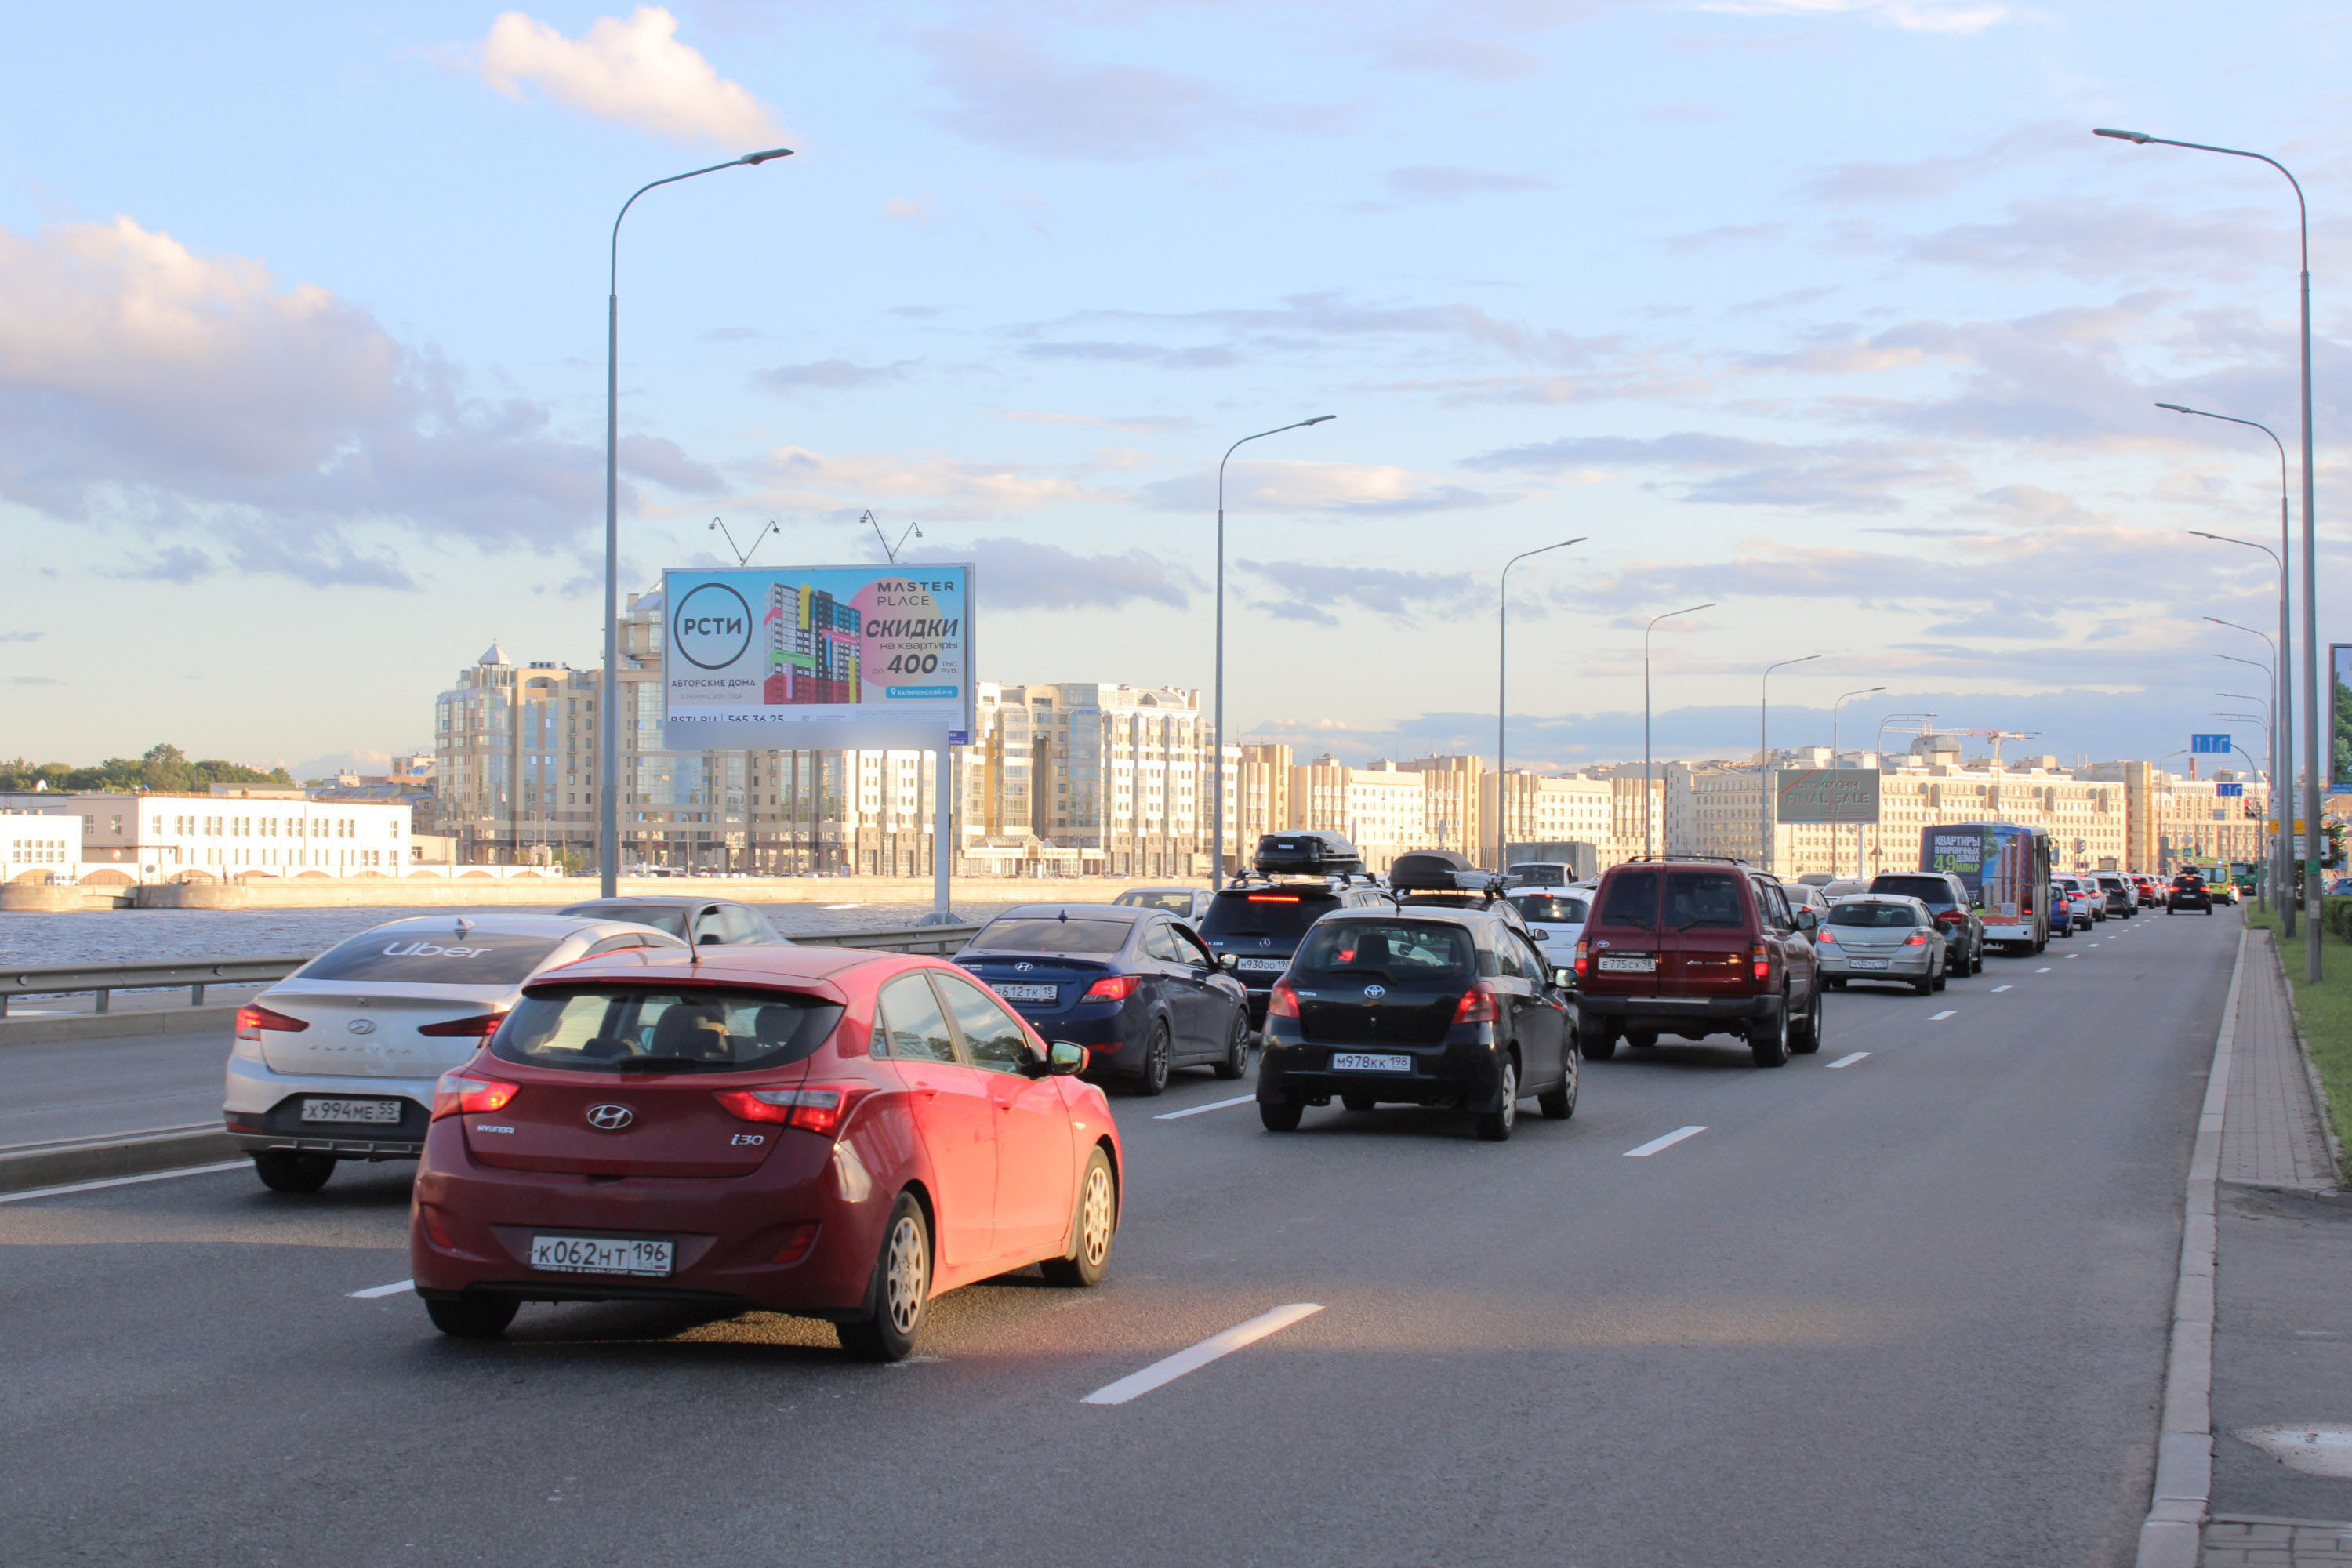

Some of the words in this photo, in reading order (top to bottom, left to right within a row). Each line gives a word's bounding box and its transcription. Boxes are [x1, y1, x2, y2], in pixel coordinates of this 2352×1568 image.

[878, 581, 954, 592] MASTER
[878, 596, 929, 606] PLACE
[684, 617, 742, 636] РСТИ
[866, 619, 959, 640] СКИДКИ
[898, 641, 958, 652] квартиры
[887, 654, 938, 674] 400
[728, 679, 756, 688] ДОМА
[1836, 792, 1870, 804] SALE
[1934, 836, 1980, 846] КВАРТИРЫ
[382, 942, 494, 958] Uber
[1337, 1056, 1387, 1068] М978КК
[1390, 1057, 1408, 1066] 198
[307, 1102, 374, 1120] Х994МЕ
[379, 1102, 396, 1115] 55
[477, 1124, 514, 1134] HYUNDAI
[731, 1134, 765, 1145] i30
[539, 1240, 626, 1266] К062НТ
[633, 1243, 665, 1261] 196
